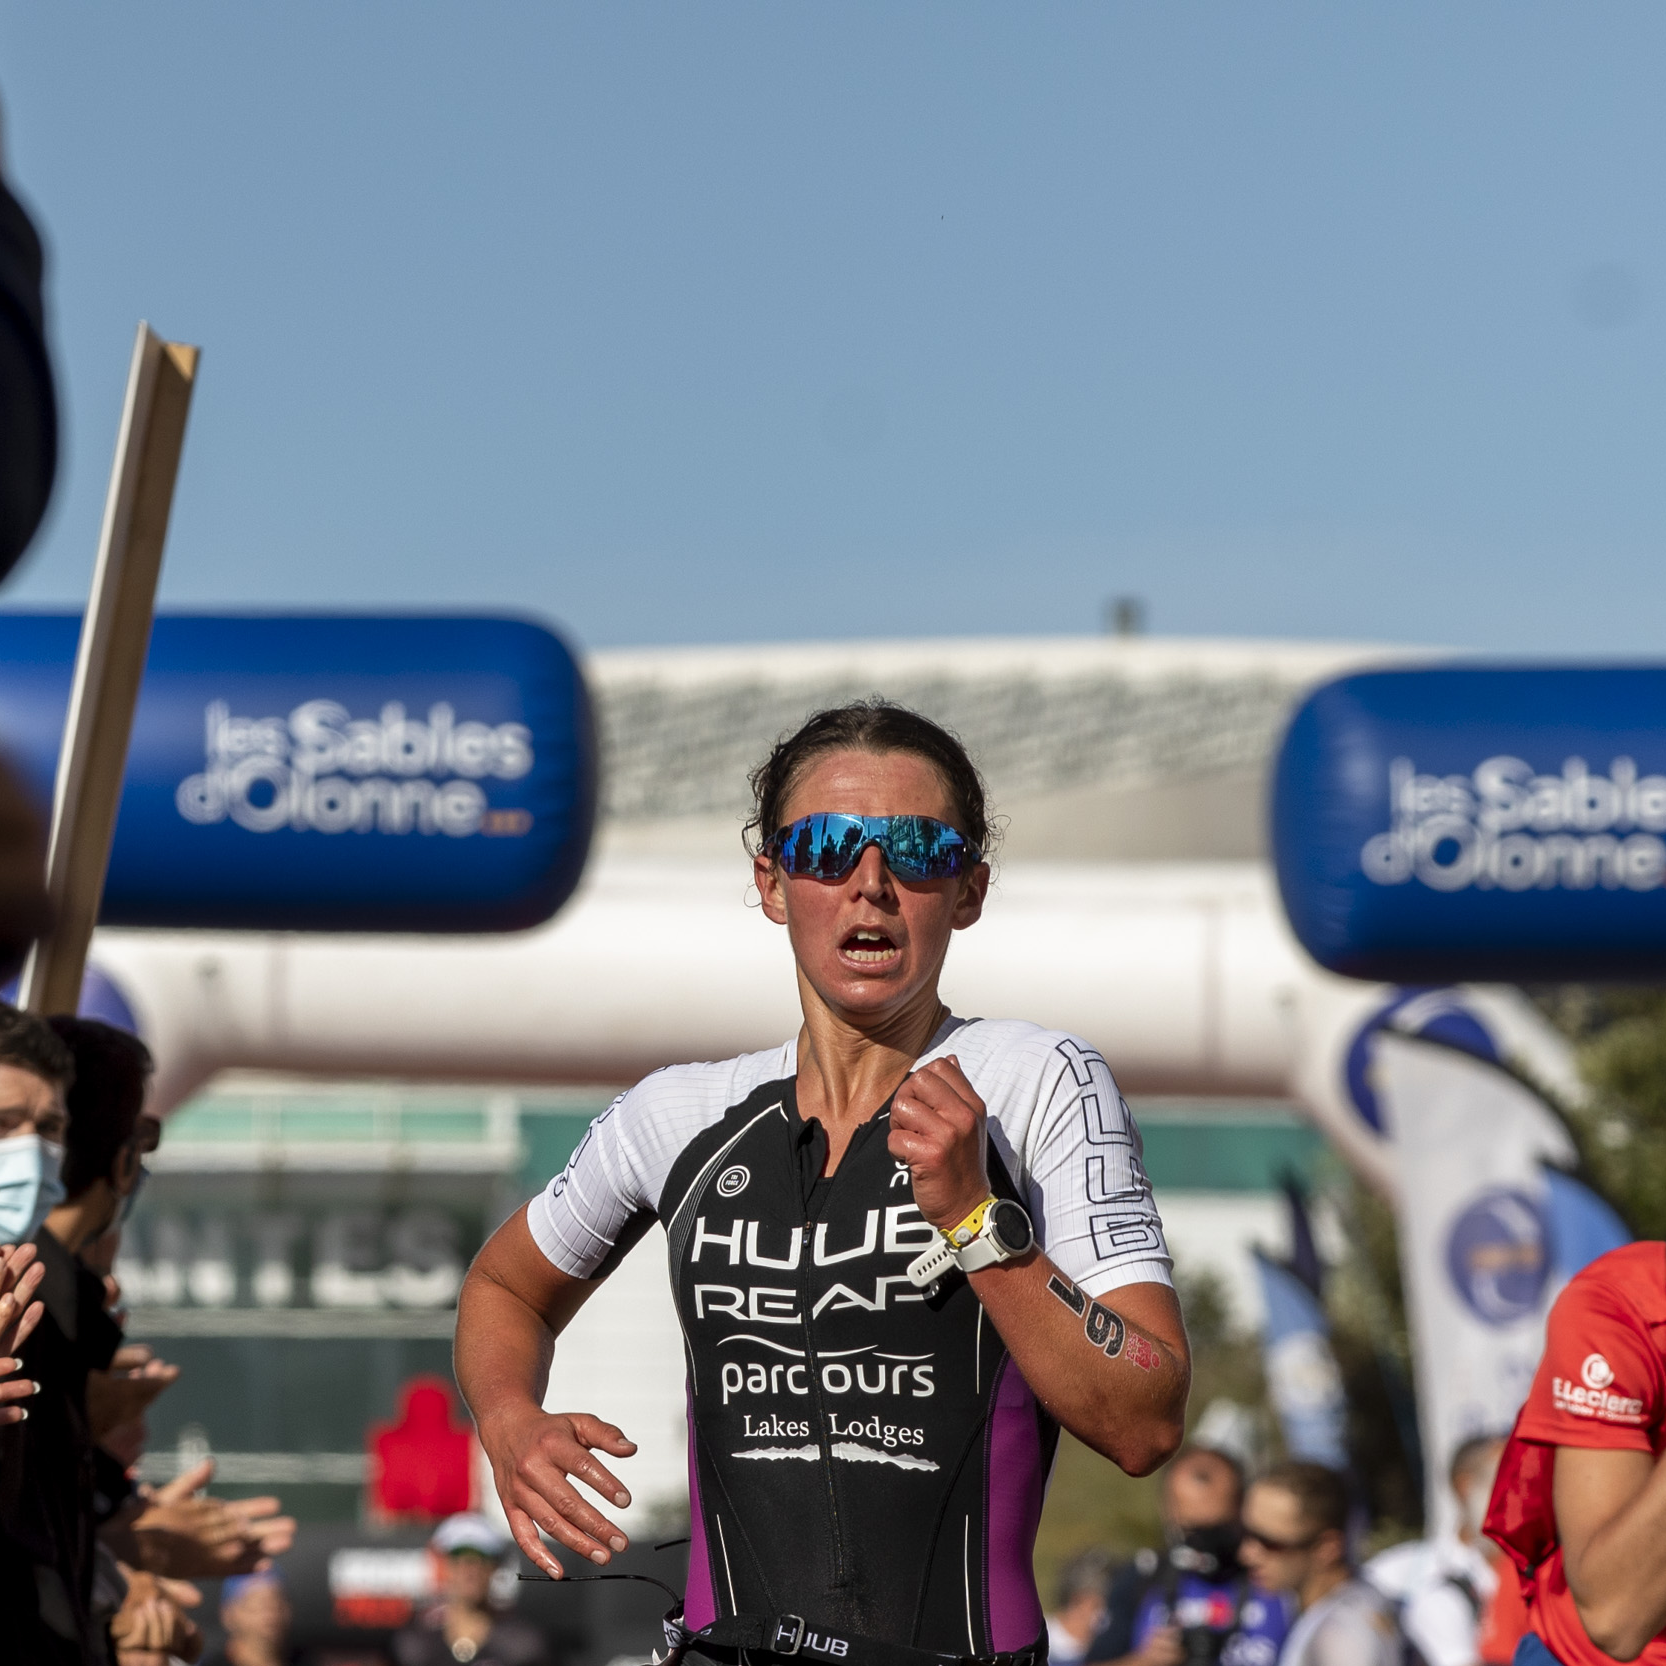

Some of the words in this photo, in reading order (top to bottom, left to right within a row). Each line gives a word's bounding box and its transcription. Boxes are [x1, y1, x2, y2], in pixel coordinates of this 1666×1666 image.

[287, 699, 535, 780] Sables
[175, 755, 488, 838] d'Olonne
[1055, 1038, 1161, 1261] HUUB
[691, 1203, 941, 1270] HUUB
[721, 1362, 935, 1405] parcours
[743, 1413, 810, 1438] Lakes
[828, 1413, 925, 1448] Lodges
